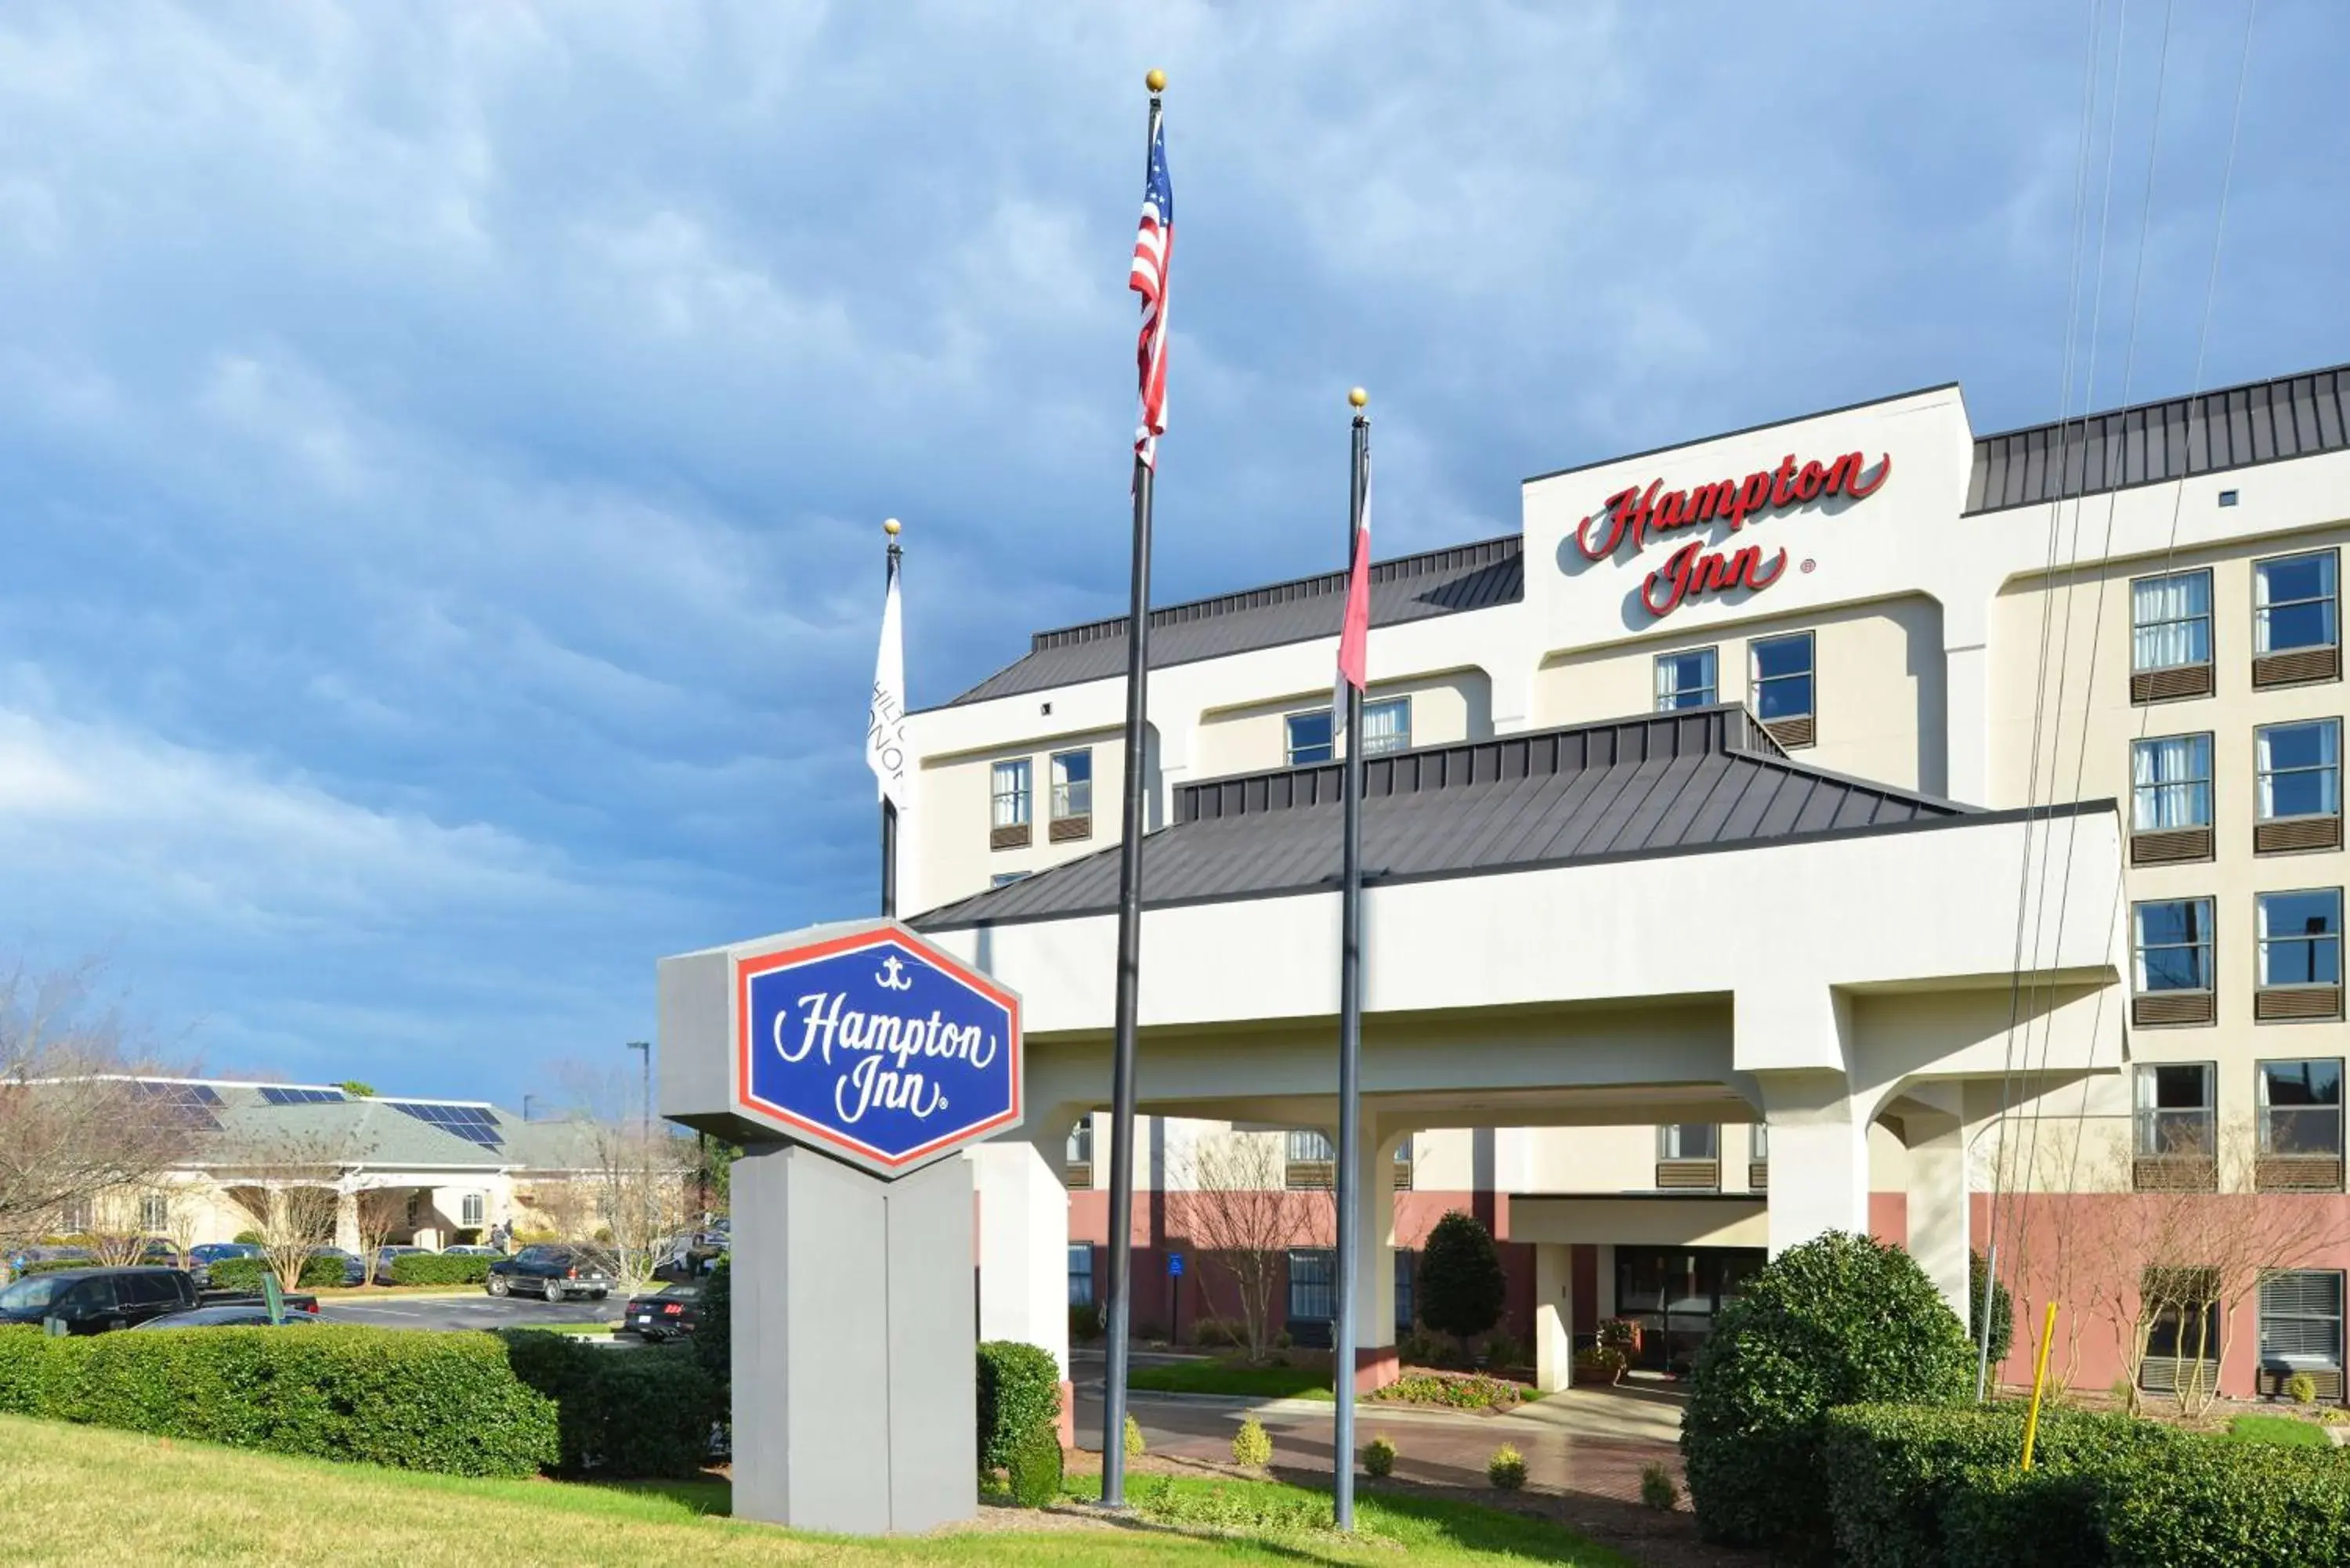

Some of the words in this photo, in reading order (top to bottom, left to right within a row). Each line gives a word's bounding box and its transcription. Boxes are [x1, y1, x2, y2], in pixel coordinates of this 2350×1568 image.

[1575, 451, 1892, 562] Hampton
[1642, 540, 1788, 616] Inn
[774, 992, 996, 1068] Hampton
[835, 1056, 939, 1123] Inn
